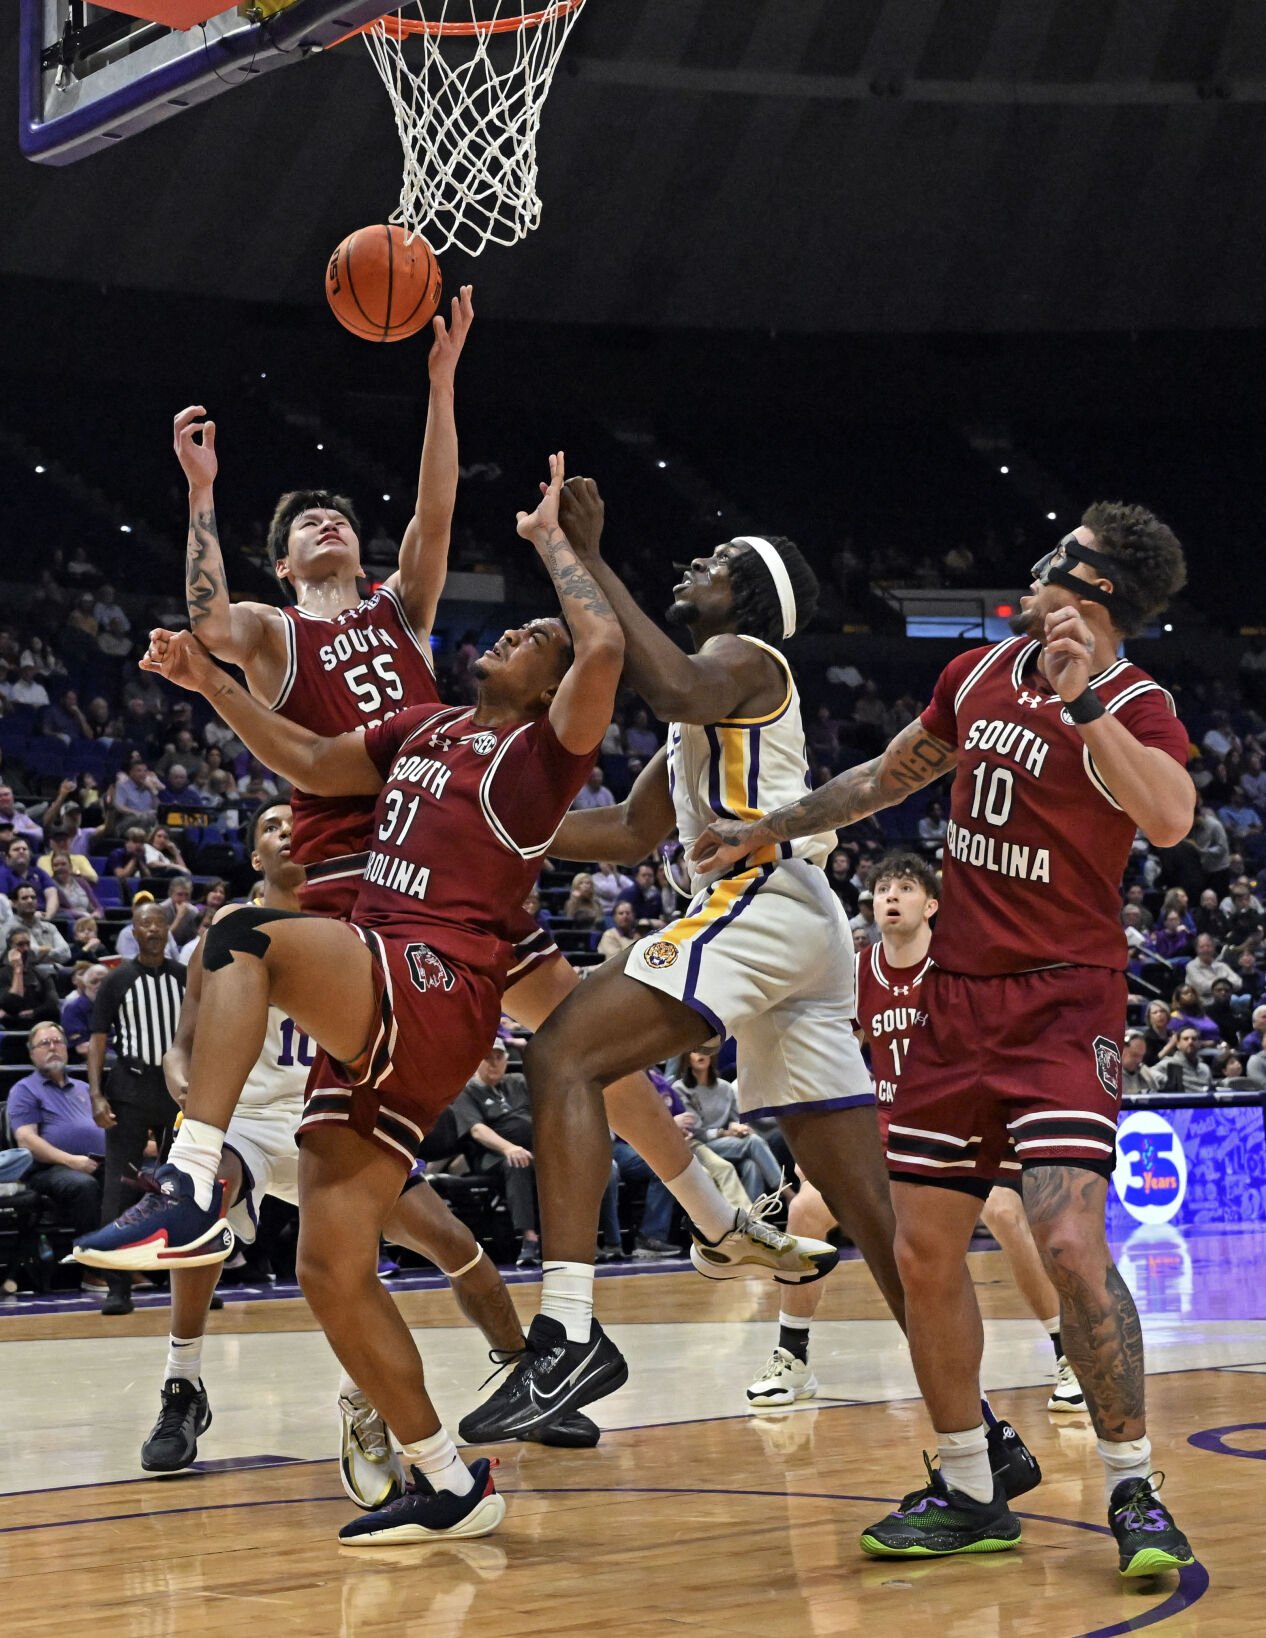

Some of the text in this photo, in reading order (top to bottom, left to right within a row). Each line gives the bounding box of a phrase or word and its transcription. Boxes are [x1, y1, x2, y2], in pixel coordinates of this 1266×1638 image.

[319, 625, 398, 672] SOUTH
[343, 653, 404, 713] 55
[473, 733, 497, 755] SEC
[965, 719, 1049, 778] SOUTH
[387, 756, 452, 800] SOUTH
[970, 761, 1014, 826] 10
[378, 789, 420, 846] 31
[1118, 1131, 1181, 1207] 35
[1143, 1171, 1178, 1194] Years
